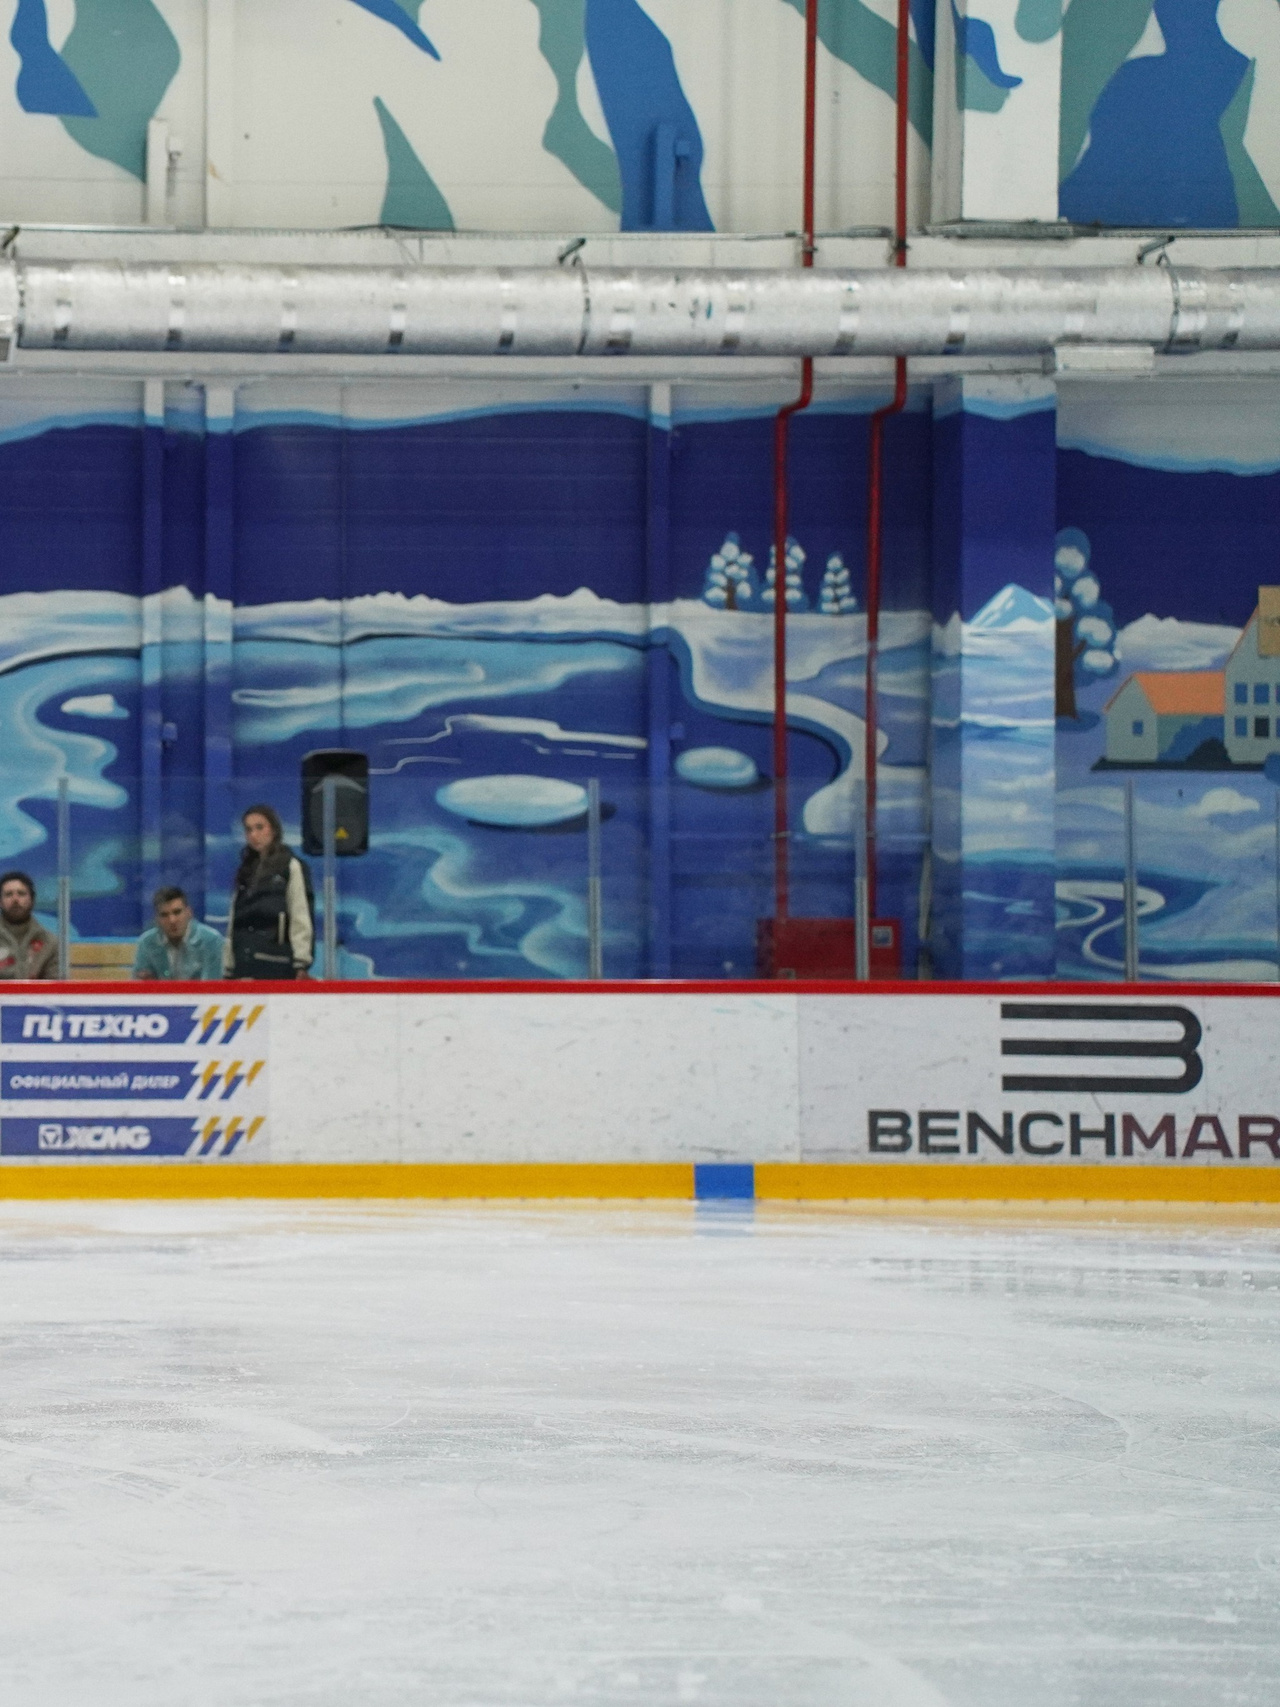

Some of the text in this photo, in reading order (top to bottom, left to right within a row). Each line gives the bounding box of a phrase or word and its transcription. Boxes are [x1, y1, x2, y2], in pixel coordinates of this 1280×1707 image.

[22, 1013, 169, 1041] ГЦ ТЕХНО
[64, 1126, 151, 1149] XCMG
